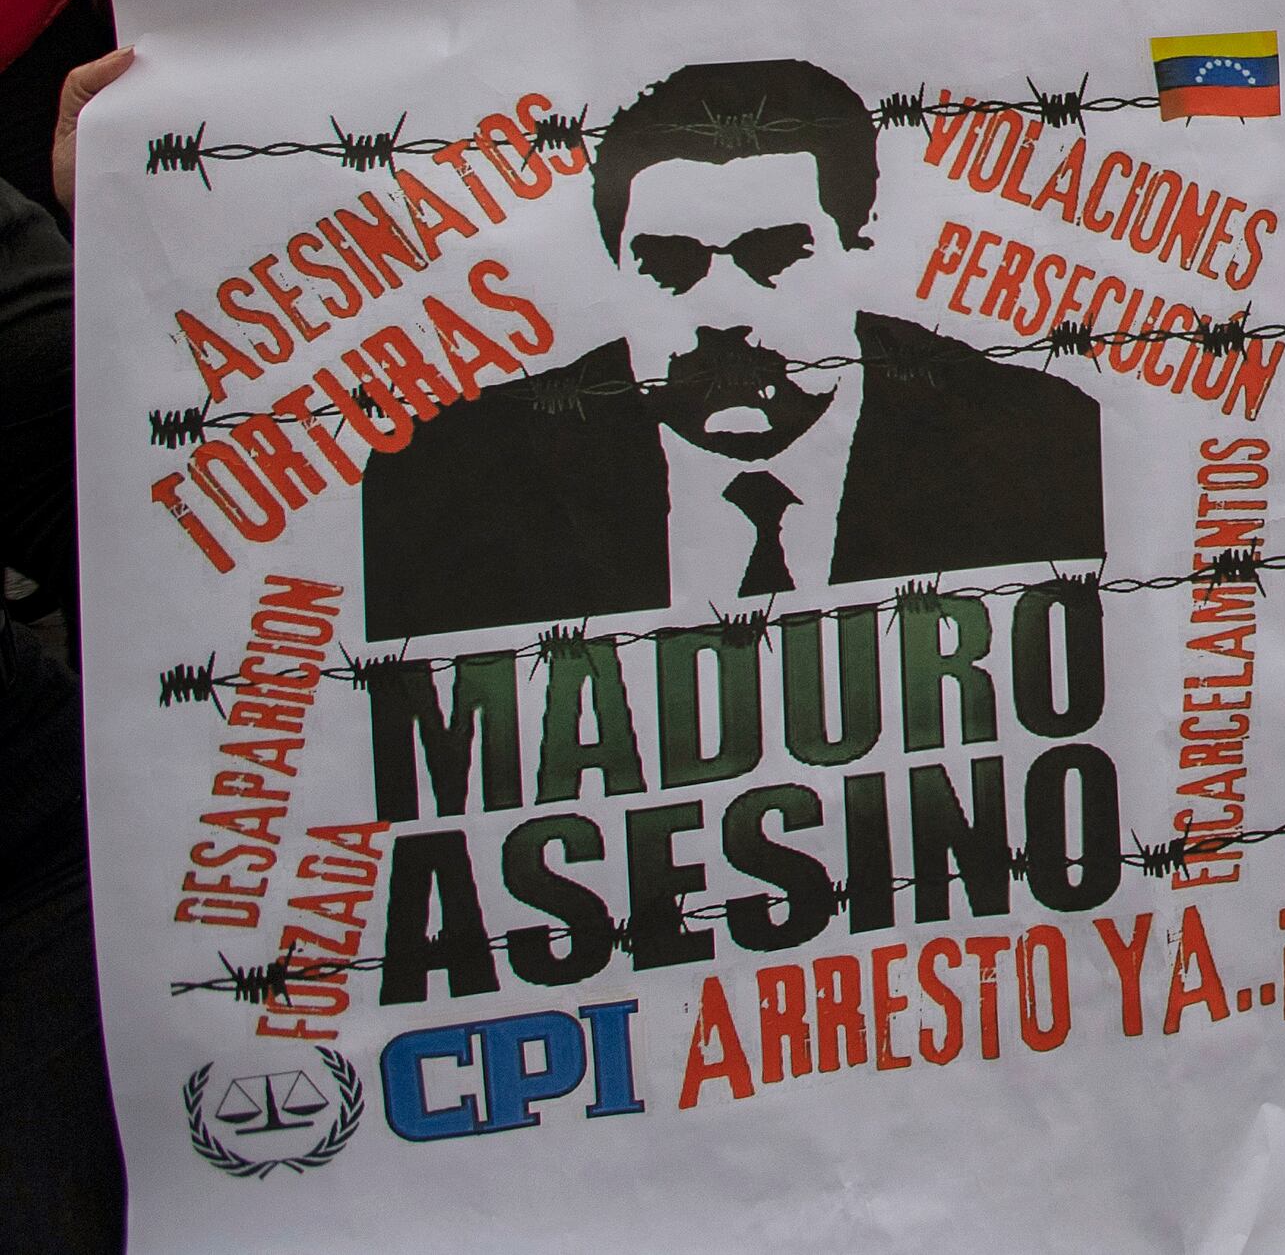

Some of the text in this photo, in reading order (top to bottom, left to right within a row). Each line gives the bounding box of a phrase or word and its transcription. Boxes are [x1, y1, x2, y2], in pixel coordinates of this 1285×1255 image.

[171, 92, 589, 405] ASESINATOS
[922, 88, 1279, 292] VIOLACIONES
[150, 258, 555, 575] TORTURAS
[173, 574, 345, 929] DESAPARICION
[362, 589, 1106, 824] MADURO
[254, 820, 392, 1042] FORZADA
[378, 743, 1123, 1006] ASESINO
[378, 998, 646, 1144] CPI
[678, 923, 1073, 1112] ARRESTO
